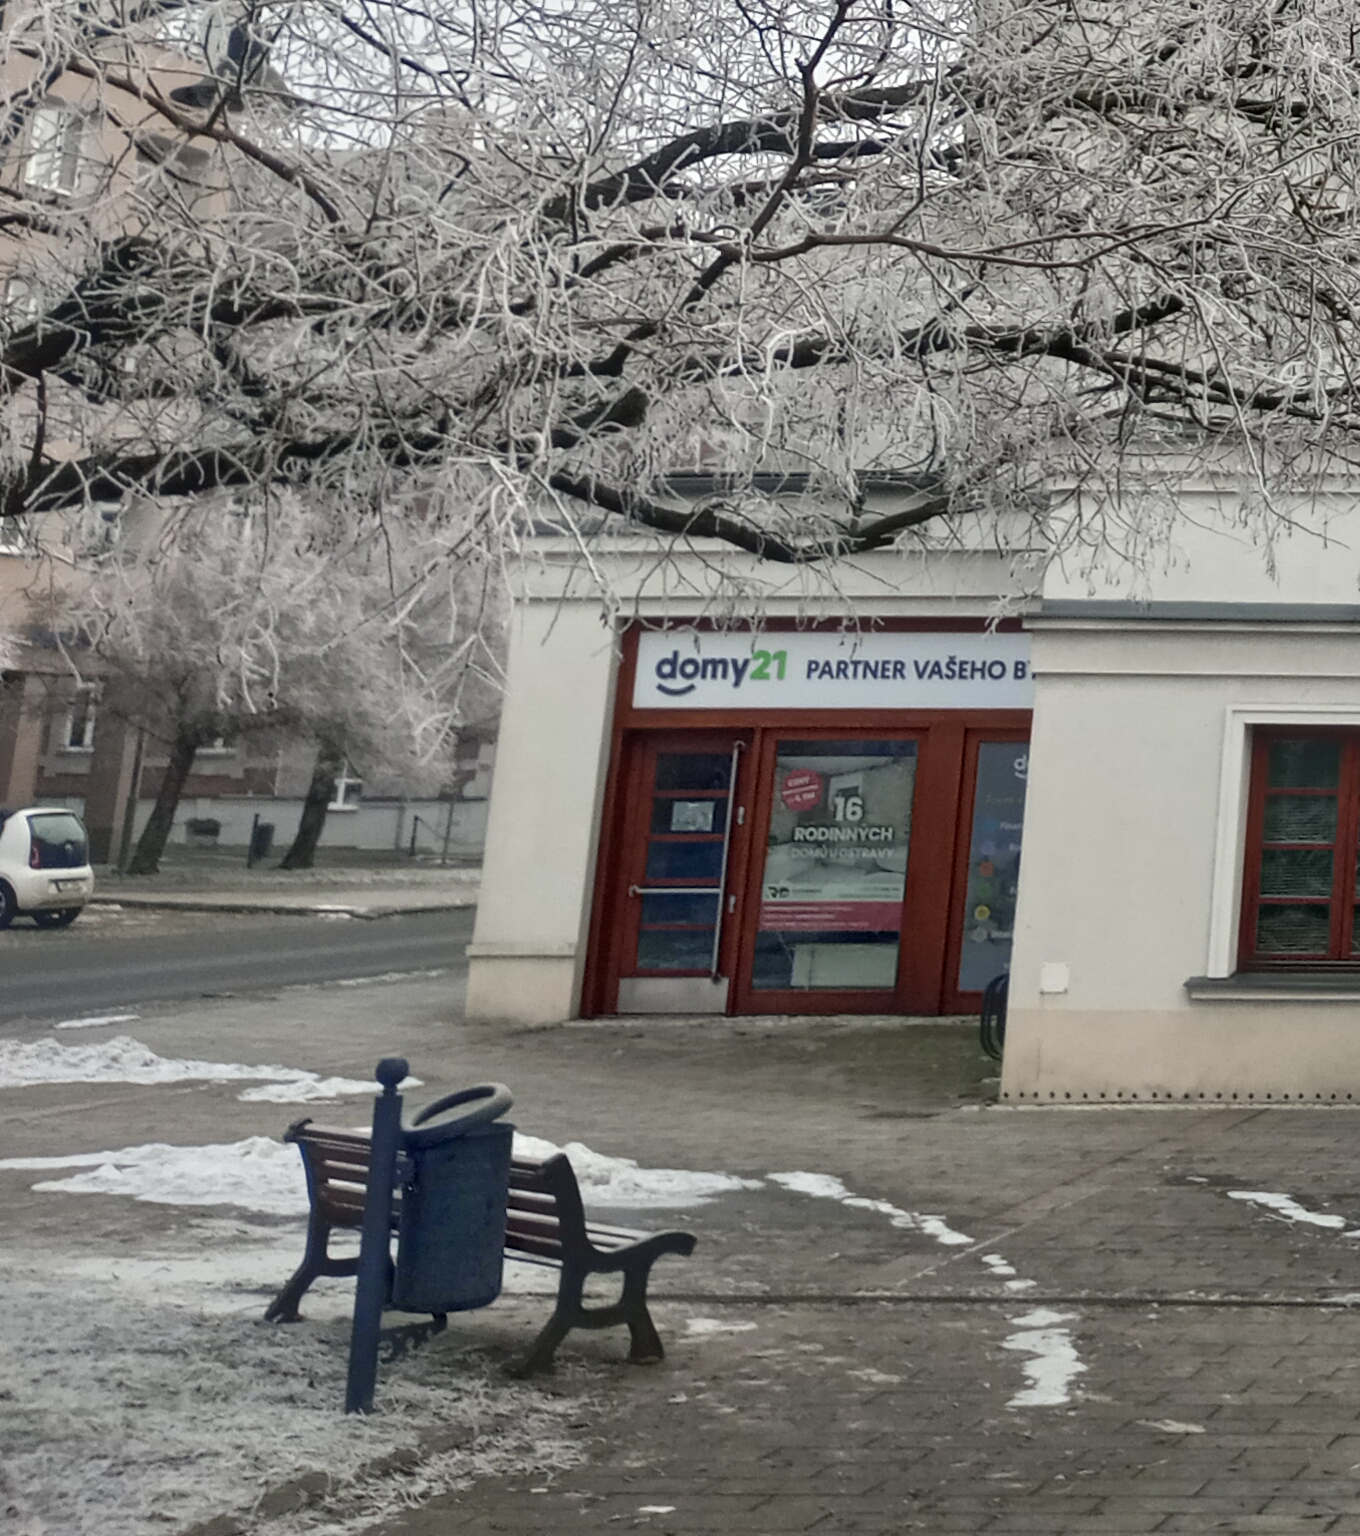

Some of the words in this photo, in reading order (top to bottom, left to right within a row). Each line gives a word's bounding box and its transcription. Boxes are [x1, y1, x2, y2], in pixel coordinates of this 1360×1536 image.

[655, 650, 787, 689] domy21
[806, 659, 906, 681] PARTNER
[913, 654, 1007, 681] VAŠEHO
[1012, 659, 1036, 681] B
[834, 795, 864, 822] 16
[793, 822, 894, 842] RODINNÝCH
